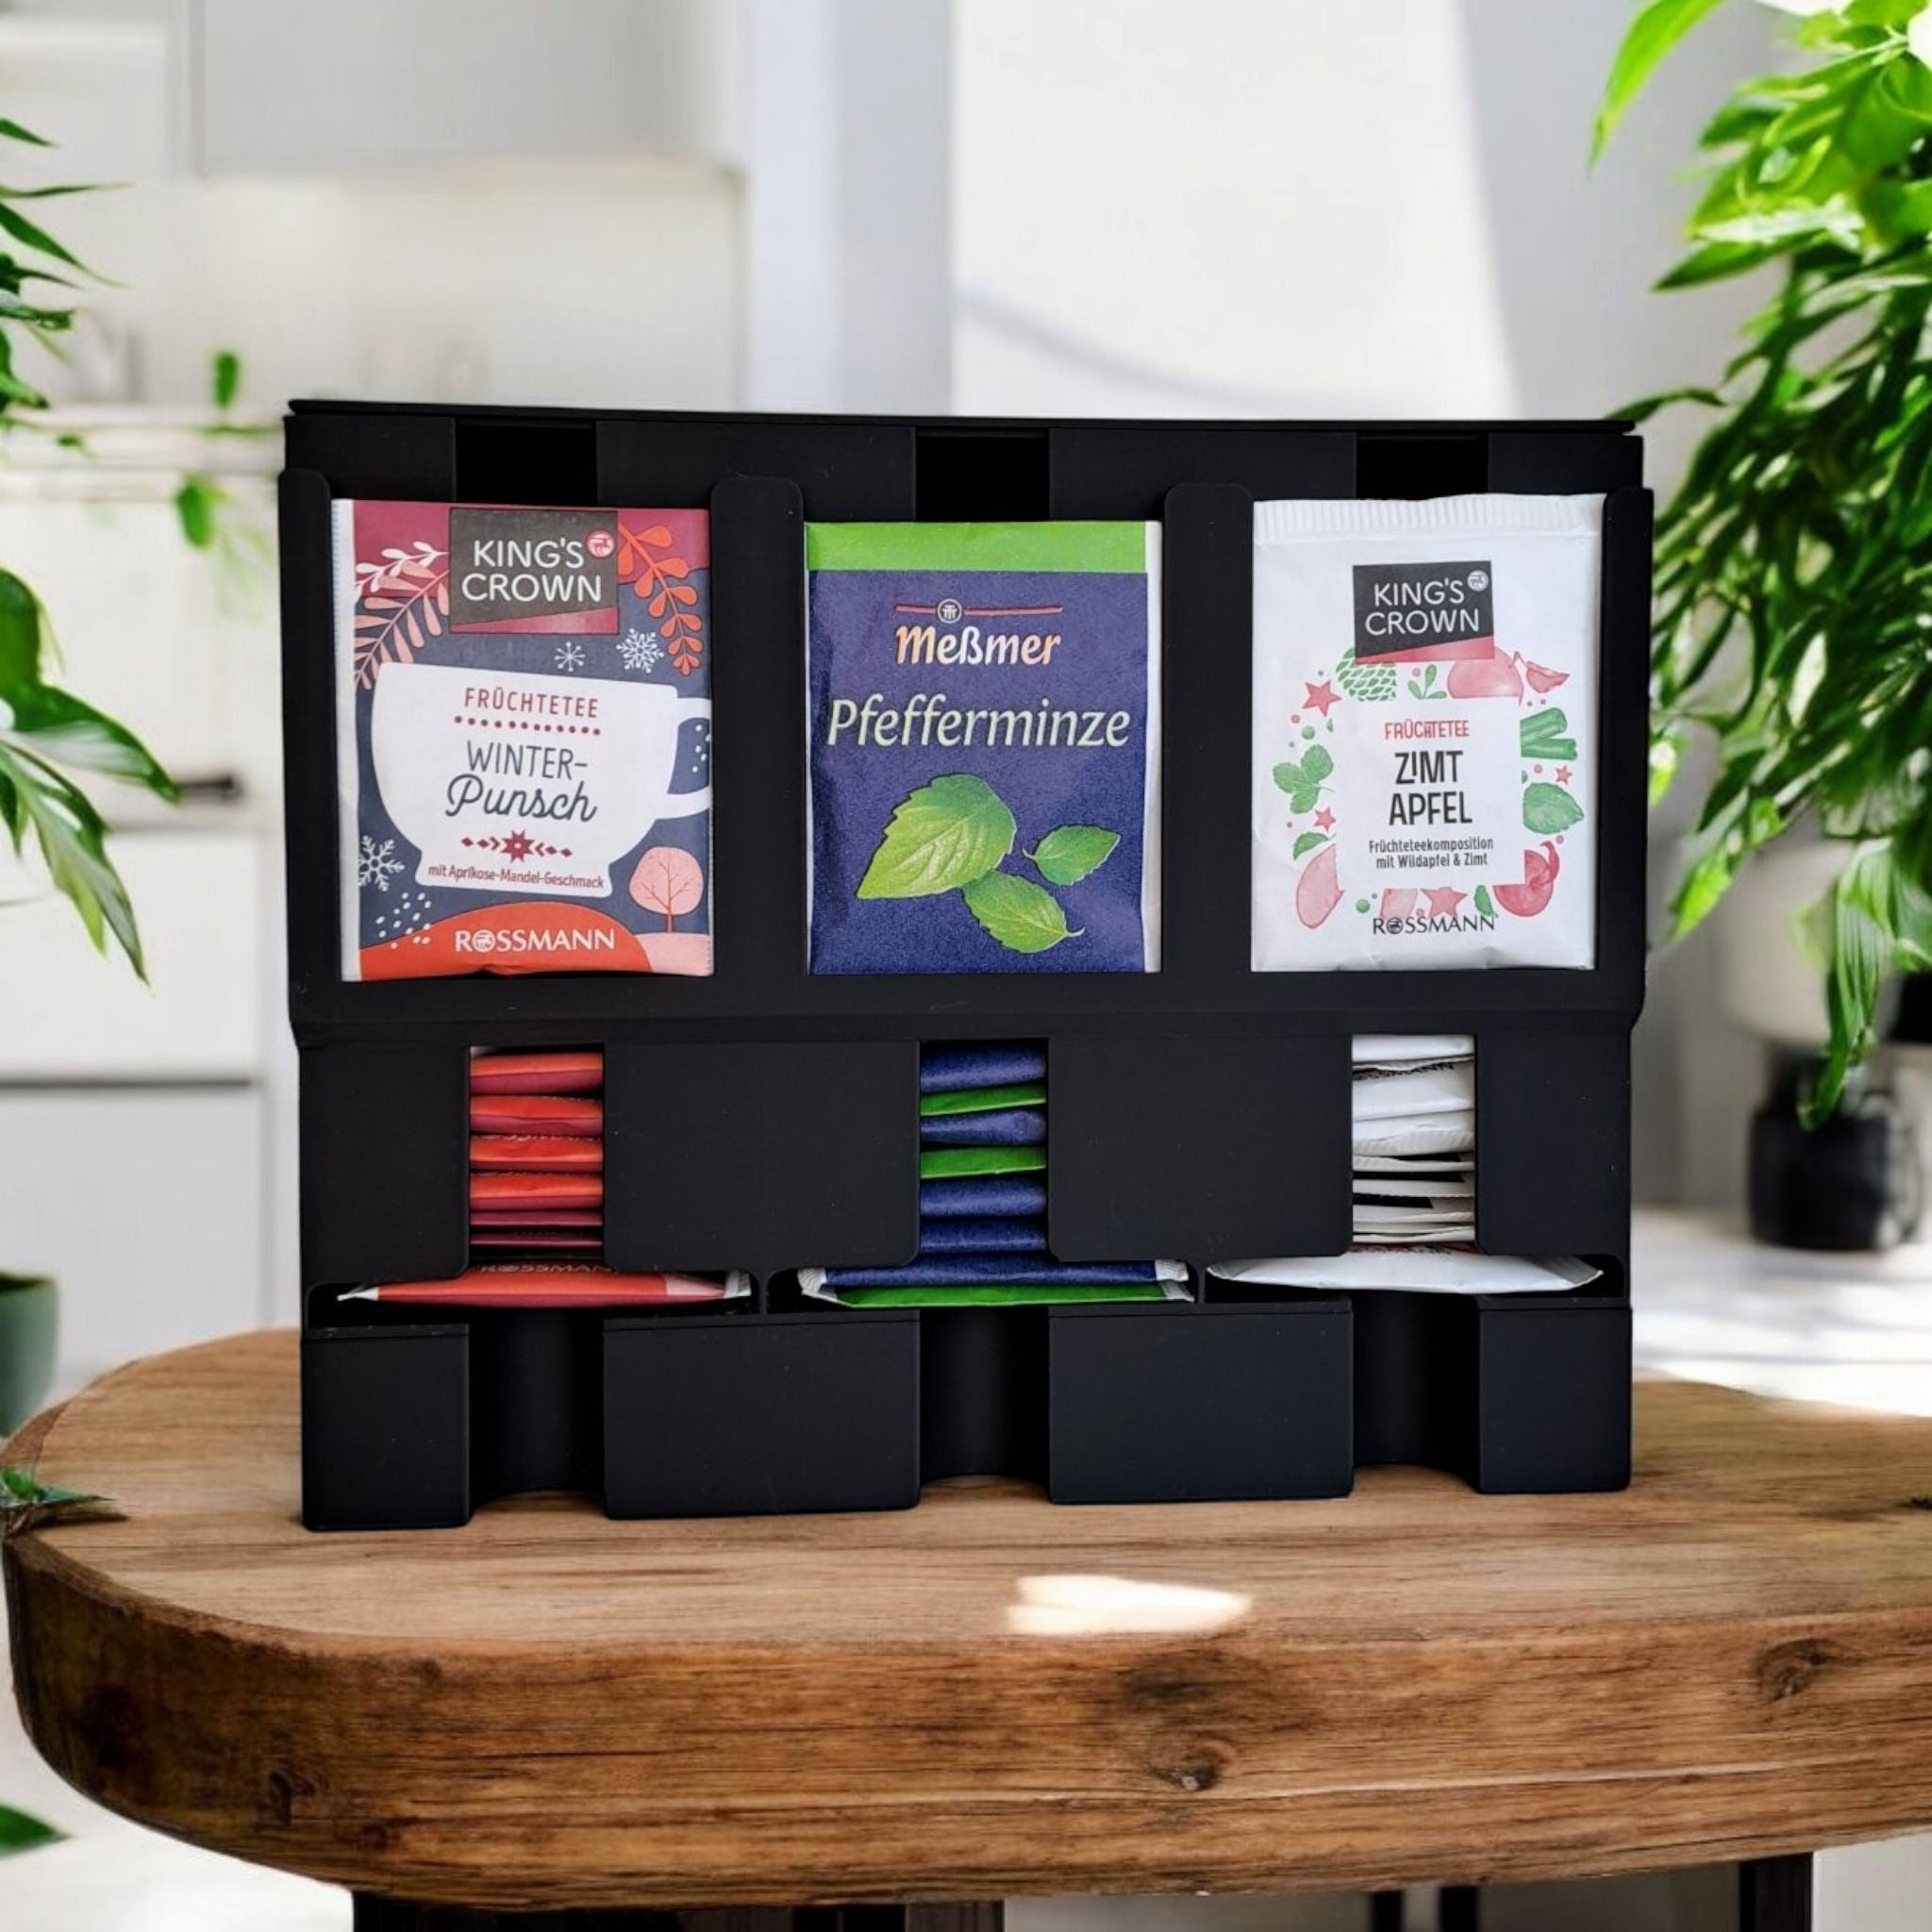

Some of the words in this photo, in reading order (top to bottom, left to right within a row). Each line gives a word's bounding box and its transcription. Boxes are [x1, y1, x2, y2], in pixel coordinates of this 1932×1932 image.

[474, 538, 584, 569] KING'S
[461, 573, 602, 603] CROWN
[1374, 578, 1465, 608] KING'S
[1365, 608, 1480, 637] CROWN
[895, 625, 1061, 665] Meßmer
[464, 687, 600, 719] FRÜCHTETEE
[827, 693, 1131, 747] Pfefferminze
[1385, 719, 1470, 741] FRÜCHTETEE
[467, 740, 588, 780] WINTER-
[1394, 750, 1463, 784] ZIMT
[445, 774, 598, 823] Punsch
[1389, 791, 1473, 826] APFEL
[1369, 836, 1493, 853] Früchteteekomposition
[1376, 855, 1394, 869] mit
[1397, 854, 1450, 869] Wildapfel
[1453, 853, 1460, 866] &
[1464, 853, 1489, 866] Zimt
[428, 864, 447, 877] mit
[448, 865, 605, 889] Aprikose-Mandel-Geschmack
[1374, 915, 1496, 935] ROSSMANN
[455, 928, 615, 953] ROSSMANN
